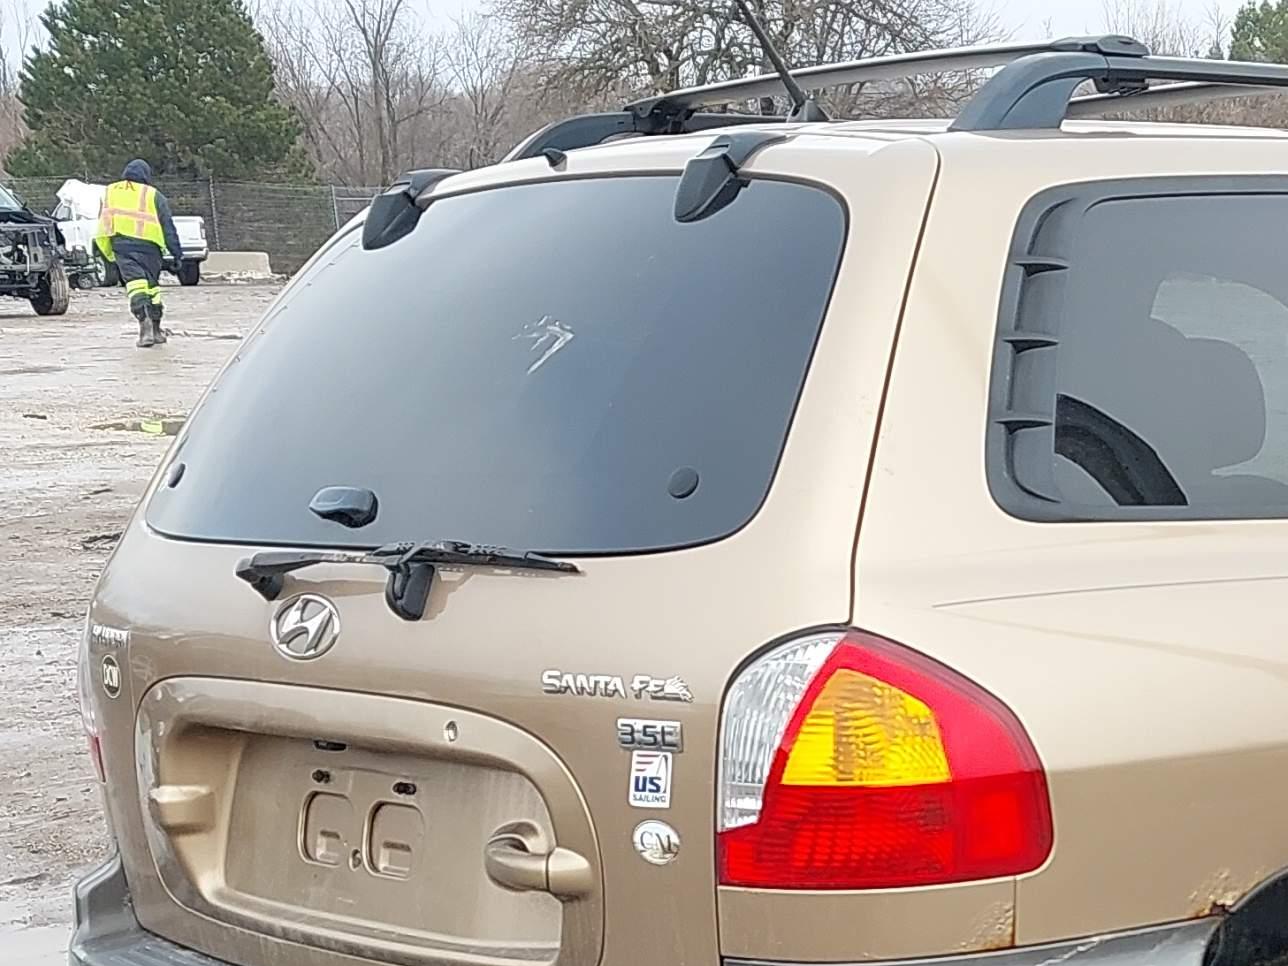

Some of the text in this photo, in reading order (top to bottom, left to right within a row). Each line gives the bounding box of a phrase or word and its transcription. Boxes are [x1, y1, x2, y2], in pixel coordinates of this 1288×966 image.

[542, 669, 627, 699] SANTA
[634, 775, 663, 793] US
[632, 793, 667, 804] SAILING
